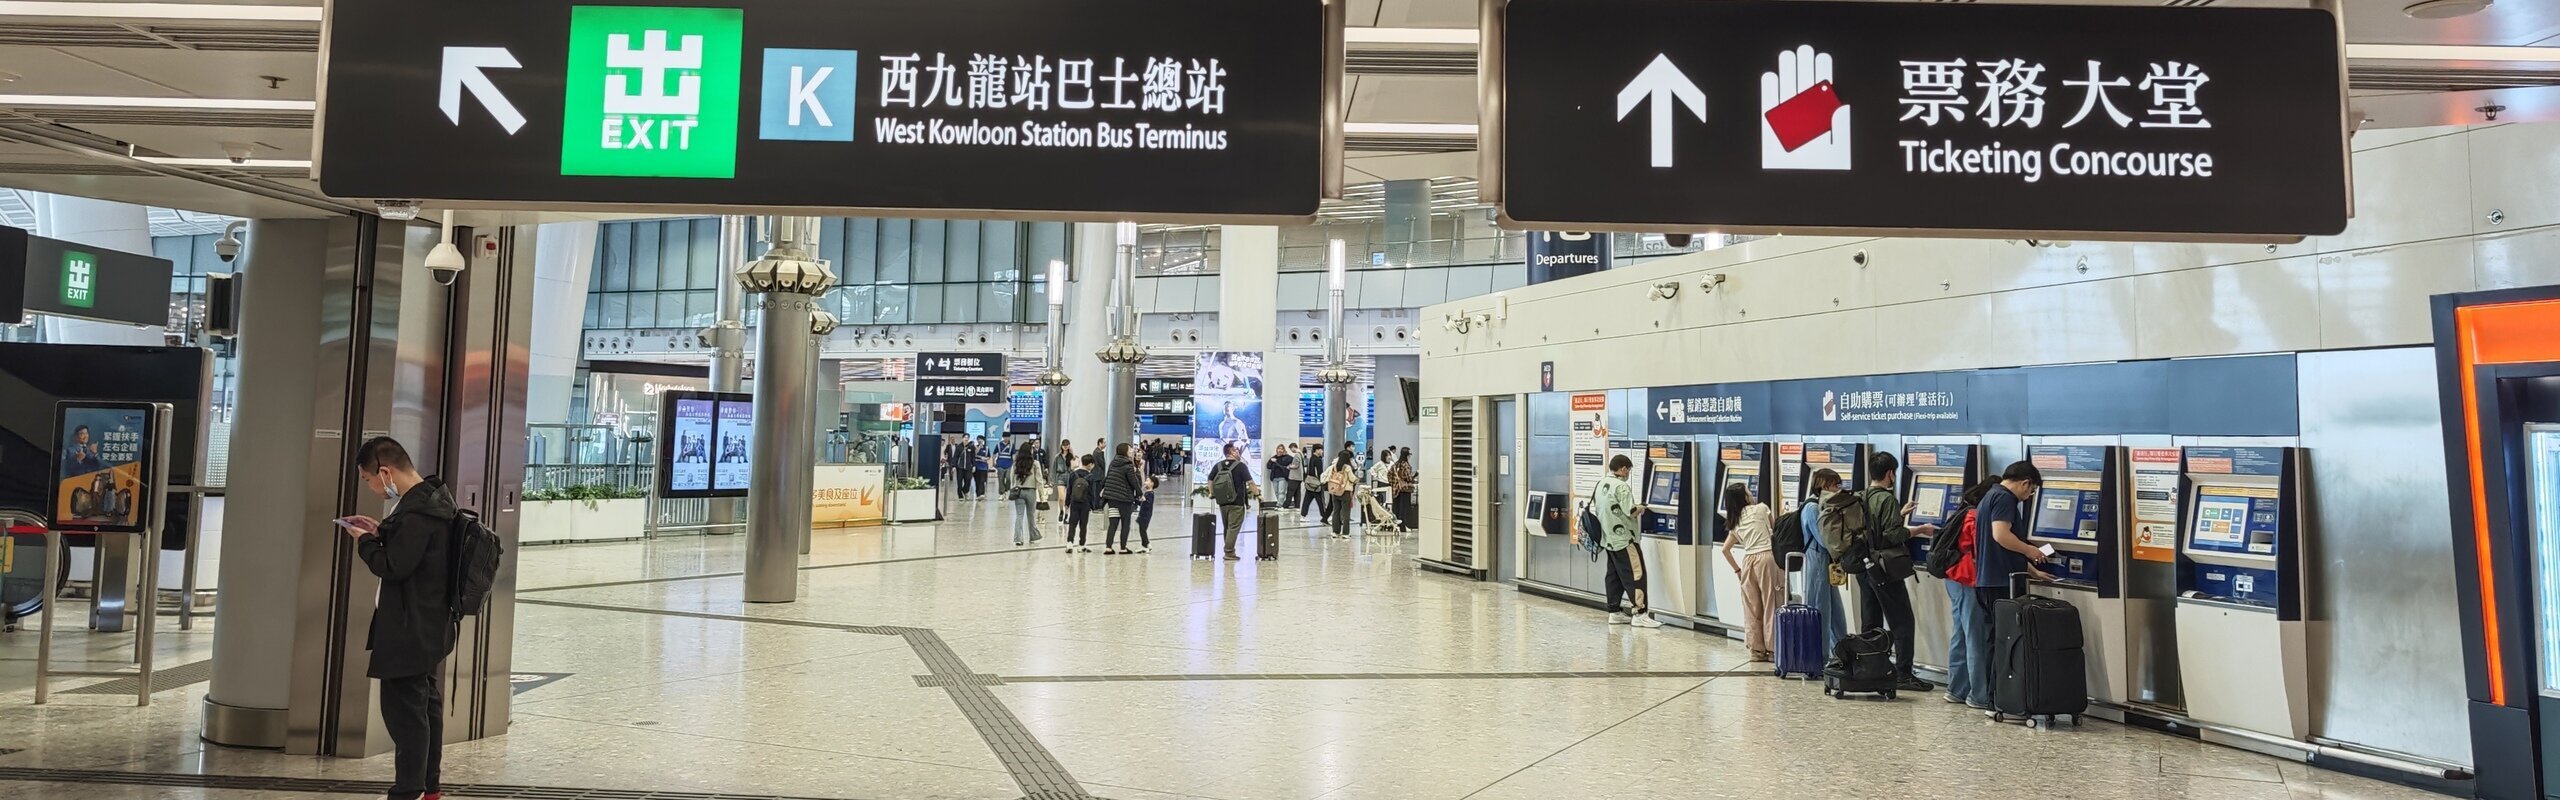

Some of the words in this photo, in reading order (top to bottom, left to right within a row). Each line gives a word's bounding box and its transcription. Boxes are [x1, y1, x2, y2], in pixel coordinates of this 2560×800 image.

[788, 66, 834, 127] K
[879, 52, 1227, 115] 西九龍站巴士總站
[1898, 57, 2212, 129] 票務大堂
[601, 118, 698, 151] EXIT
[875, 117, 925, 144] West
[929, 119, 1016, 146] Kowloon
[1021, 120, 1092, 148] Station
[1097, 122, 1133, 149] Bus
[1135, 123, 1227, 150] Terminus
[1899, 139, 2042, 183] Ticketing
[2049, 143, 2213, 177] Concourse
[1536, 253, 1599, 267] Departures
[67, 288, 89, 300] EXIT
[1841, 412, 1871, 421] Self-service
[1871, 411, 1887, 420] ticket
[1888, 411, 1914, 421] purchase
